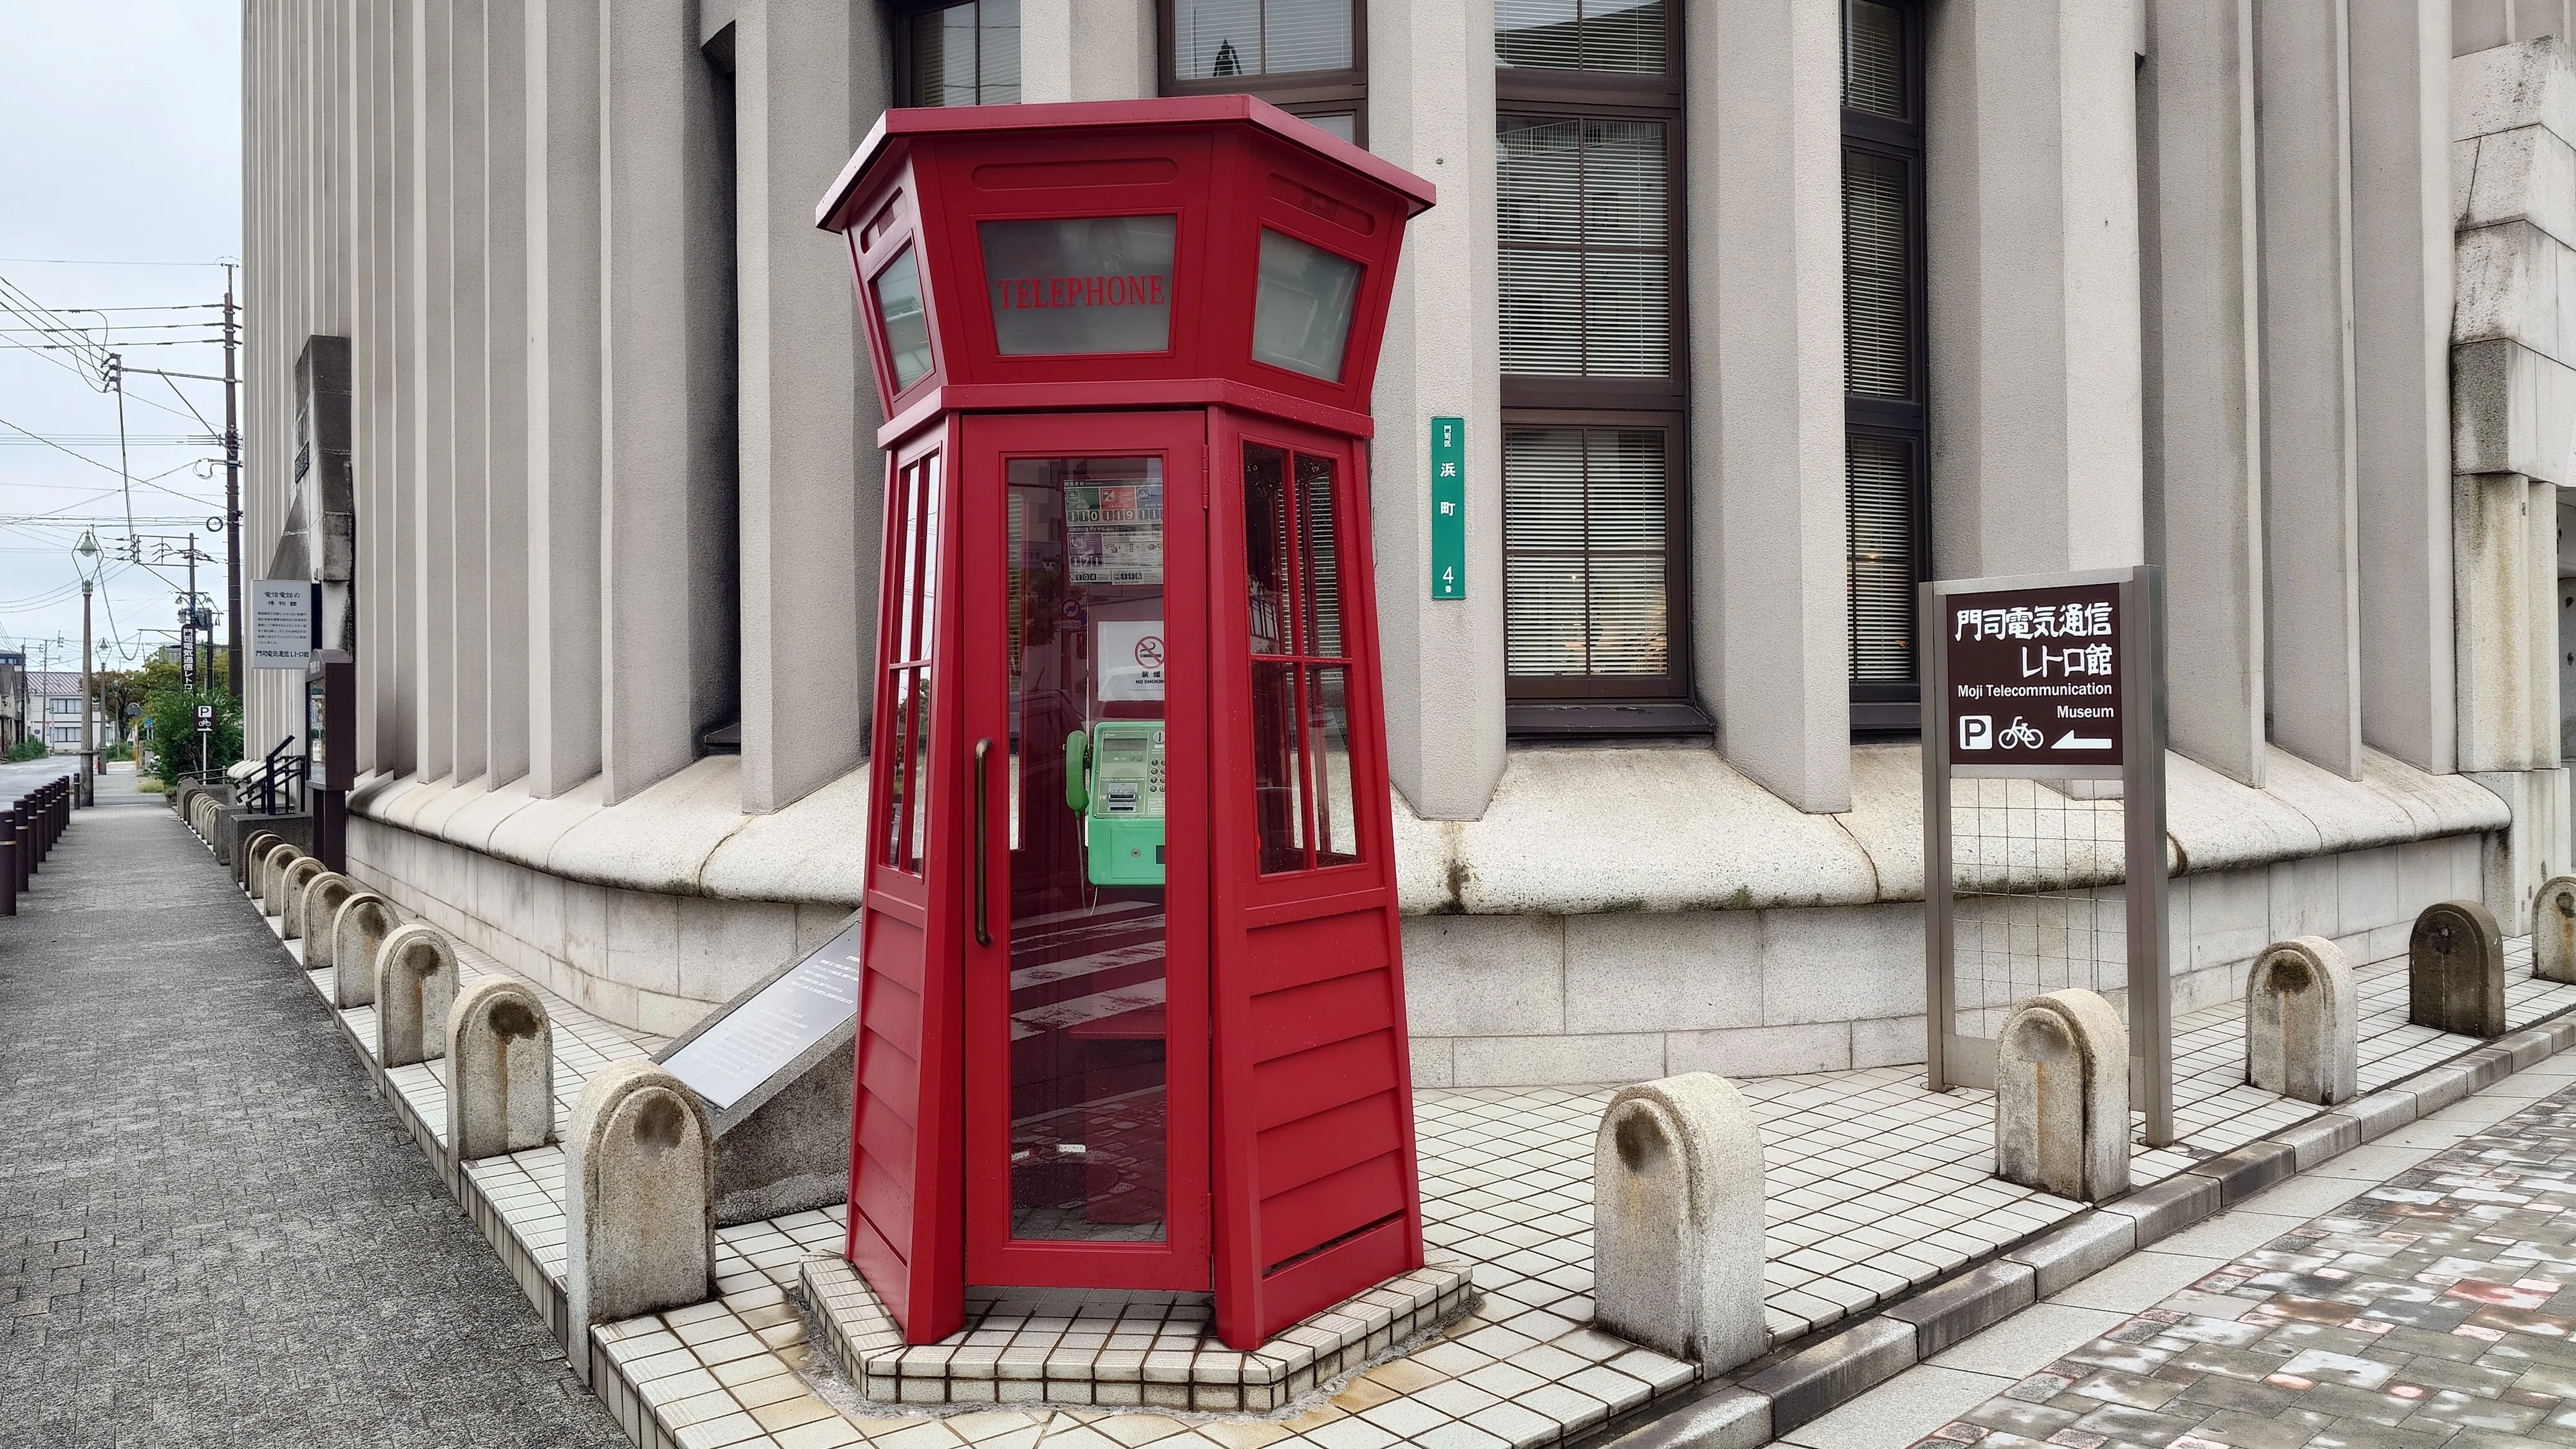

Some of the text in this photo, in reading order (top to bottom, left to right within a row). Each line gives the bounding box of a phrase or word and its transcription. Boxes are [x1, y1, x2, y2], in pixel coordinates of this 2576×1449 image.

[996, 275, 1164, 309] TELEPHONE
[1443, 425, 1452, 447] 門司区
[1440, 462, 1455, 516] 浜町
[1072, 511, 1097, 521] 110
[1106, 510, 1133, 520] 119
[1074, 556, 1099, 567] 171
[1443, 566, 1454, 593] 4番
[1955, 602, 2113, 641] 門司電気通信
[2022, 643, 2113, 678] レトロ館
[1958, 681, 2112, 700] Moji Telecommunication
[2056, 705, 2114, 719] Museum
[1964, 718, 1987, 747] P
